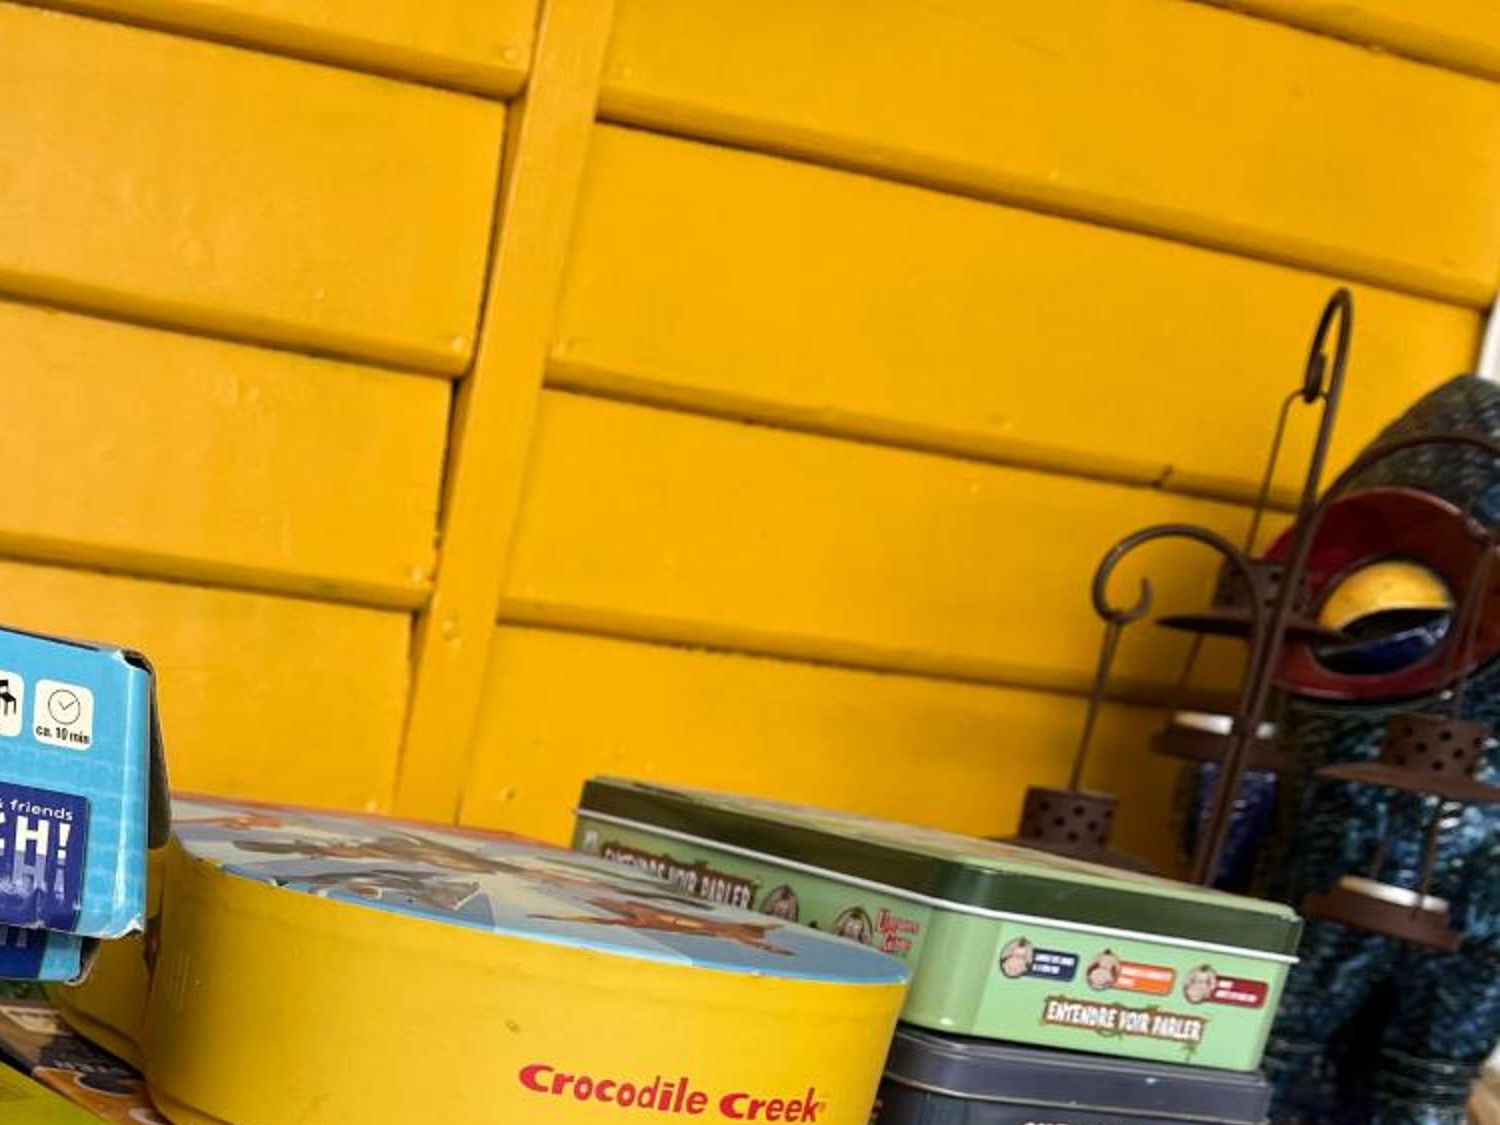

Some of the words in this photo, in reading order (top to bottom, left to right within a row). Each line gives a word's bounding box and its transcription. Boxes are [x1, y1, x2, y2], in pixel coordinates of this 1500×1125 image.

[9, 799, 73, 823] friends
[518, 1062, 708, 1116] Crocodile
[719, 1086, 817, 1124] Creek
